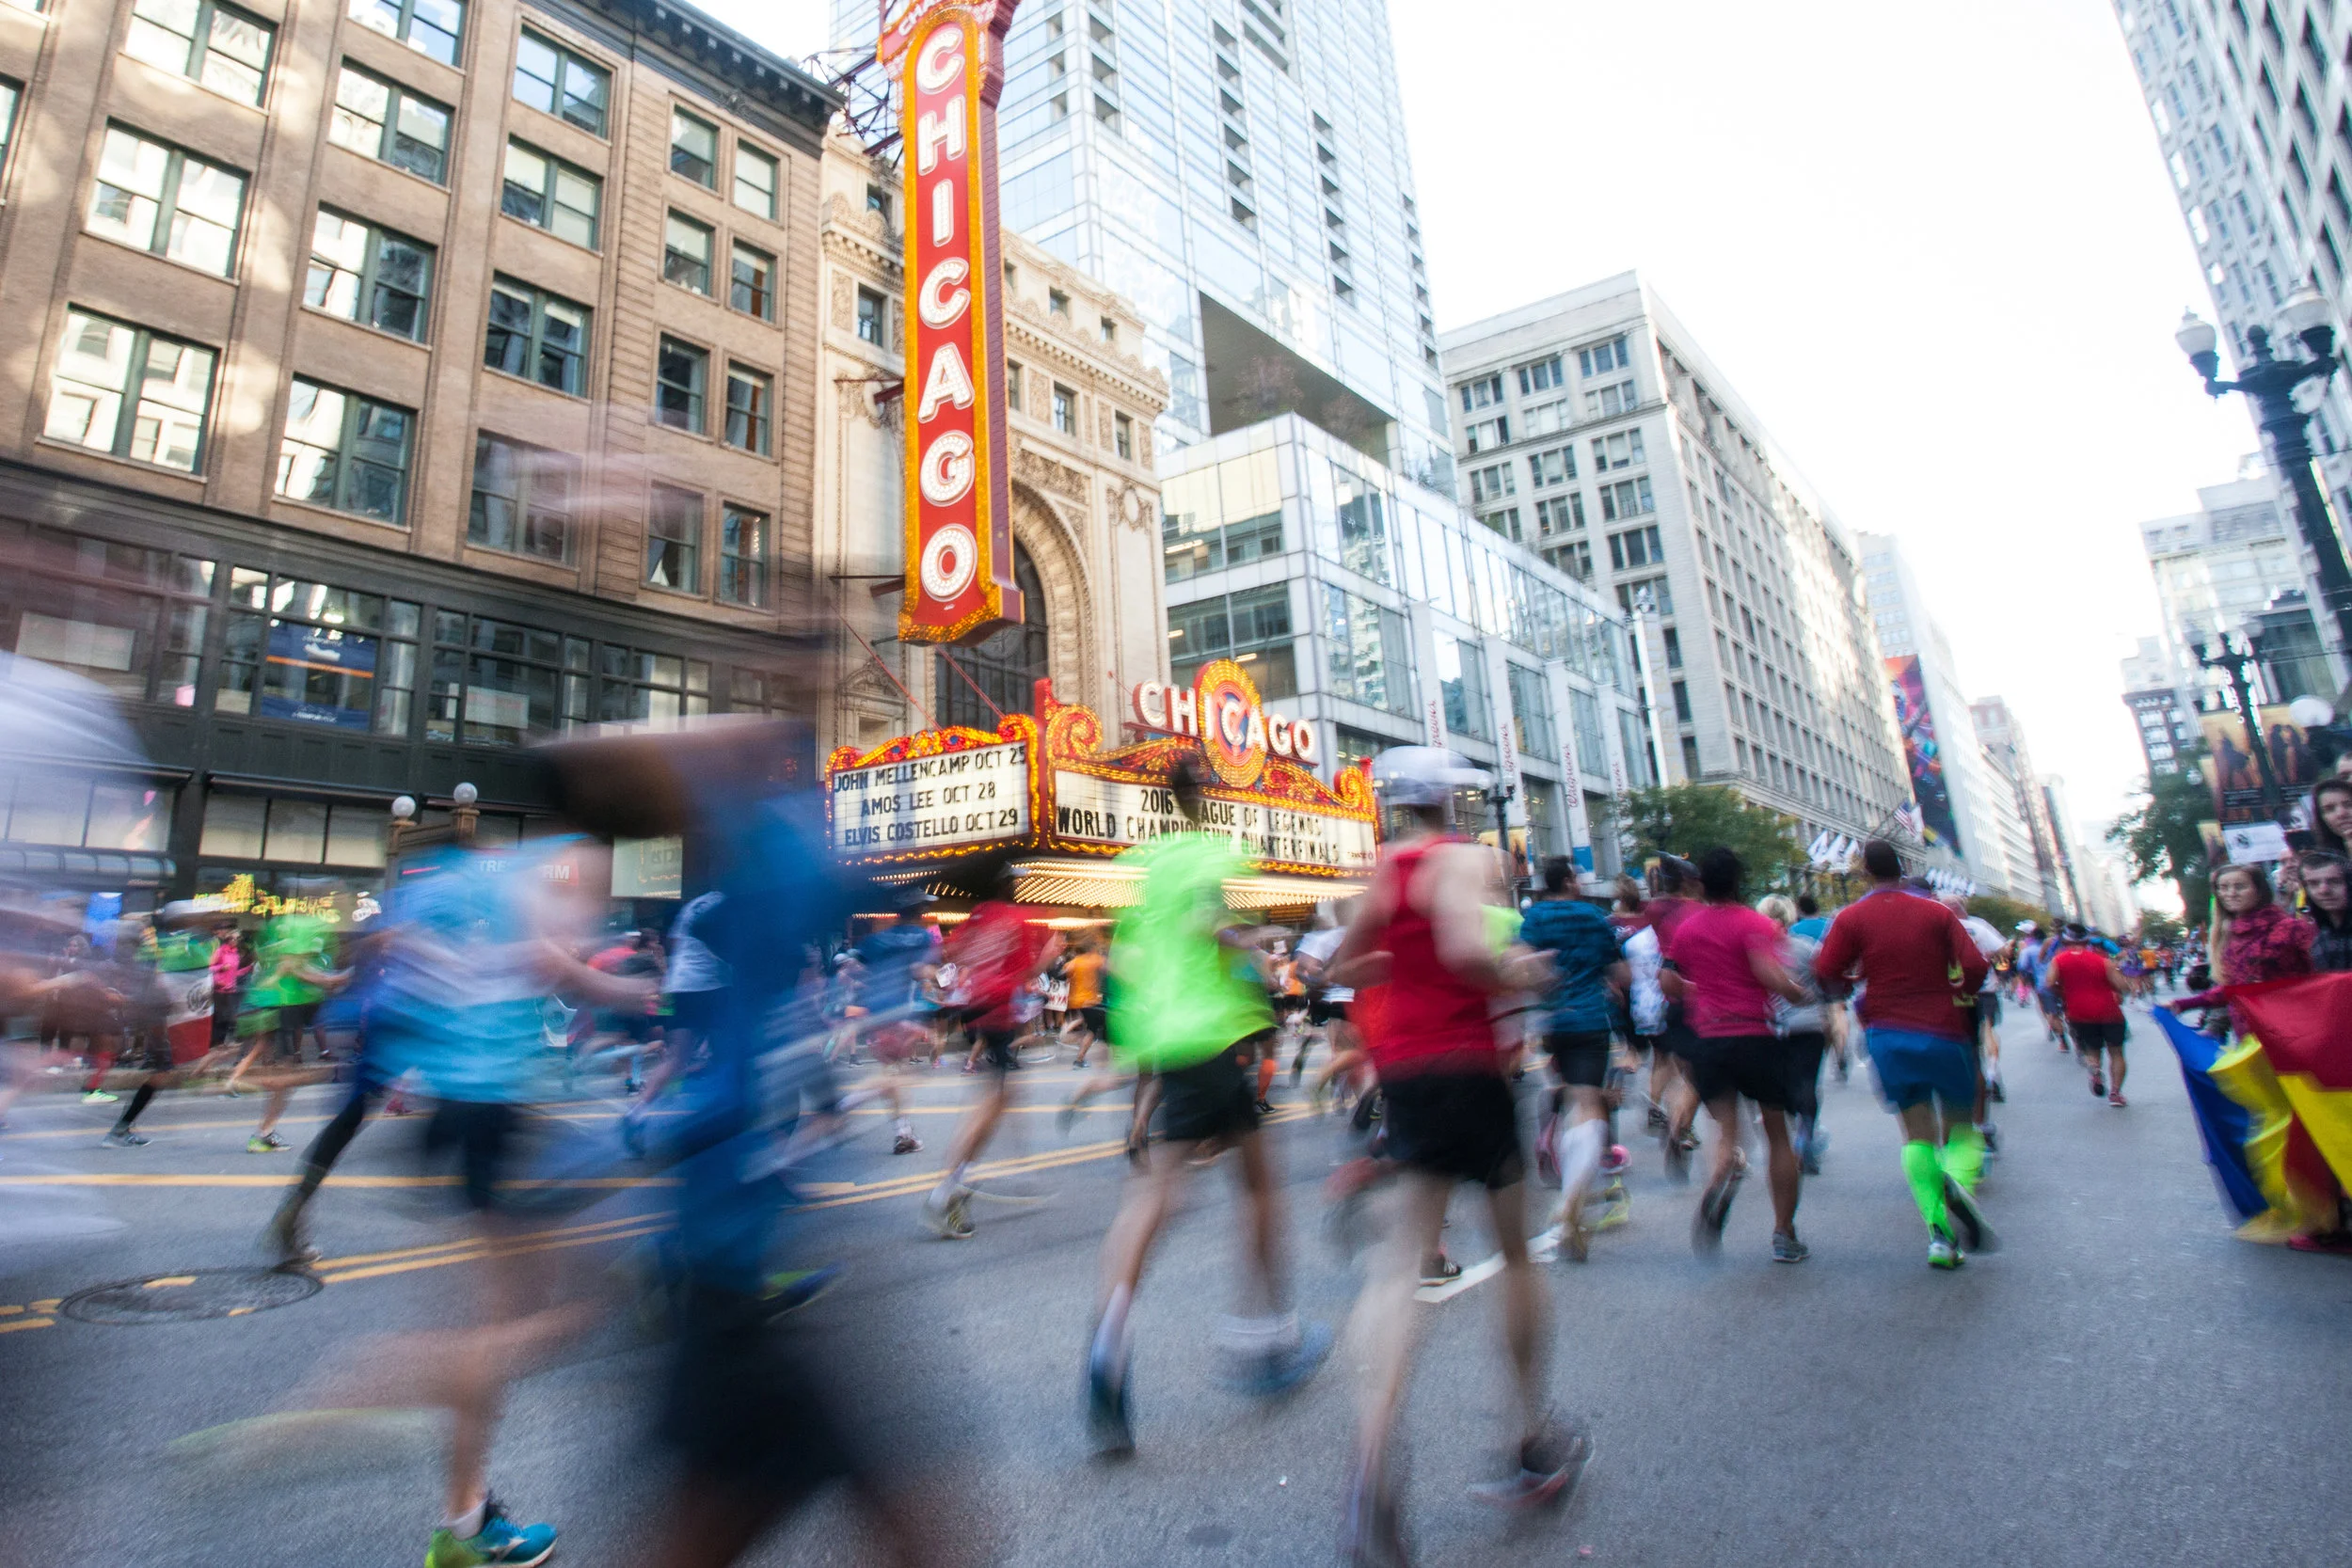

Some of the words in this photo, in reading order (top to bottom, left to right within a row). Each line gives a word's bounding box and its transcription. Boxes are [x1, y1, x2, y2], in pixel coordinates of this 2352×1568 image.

[916, 24, 978, 603] CHICAGO
[1135, 679, 1314, 761] CHICAGO
[834, 770, 868, 793] JOHN
[875, 755, 970, 786] MELLENCAMP
[975, 750, 1002, 769] OCT
[1009, 745, 1025, 765] 25
[861, 794, 901, 817] AMOS
[910, 790, 934, 811] LEE
[943, 784, 971, 804] OCT
[978, 781, 996, 800] 28
[1057, 806, 1117, 838] WORLD
[1141, 788, 1174, 816] 2016
[1200, 800, 1237, 826] AGUE
[1244, 807, 1258, 828] OF
[1266, 810, 1323, 836] LEGENDS
[846, 826, 881, 847] ELVIS
[886, 816, 959, 841] COSTELLO
[965, 809, 994, 832] OCT
[999, 808, 1019, 827] 29
